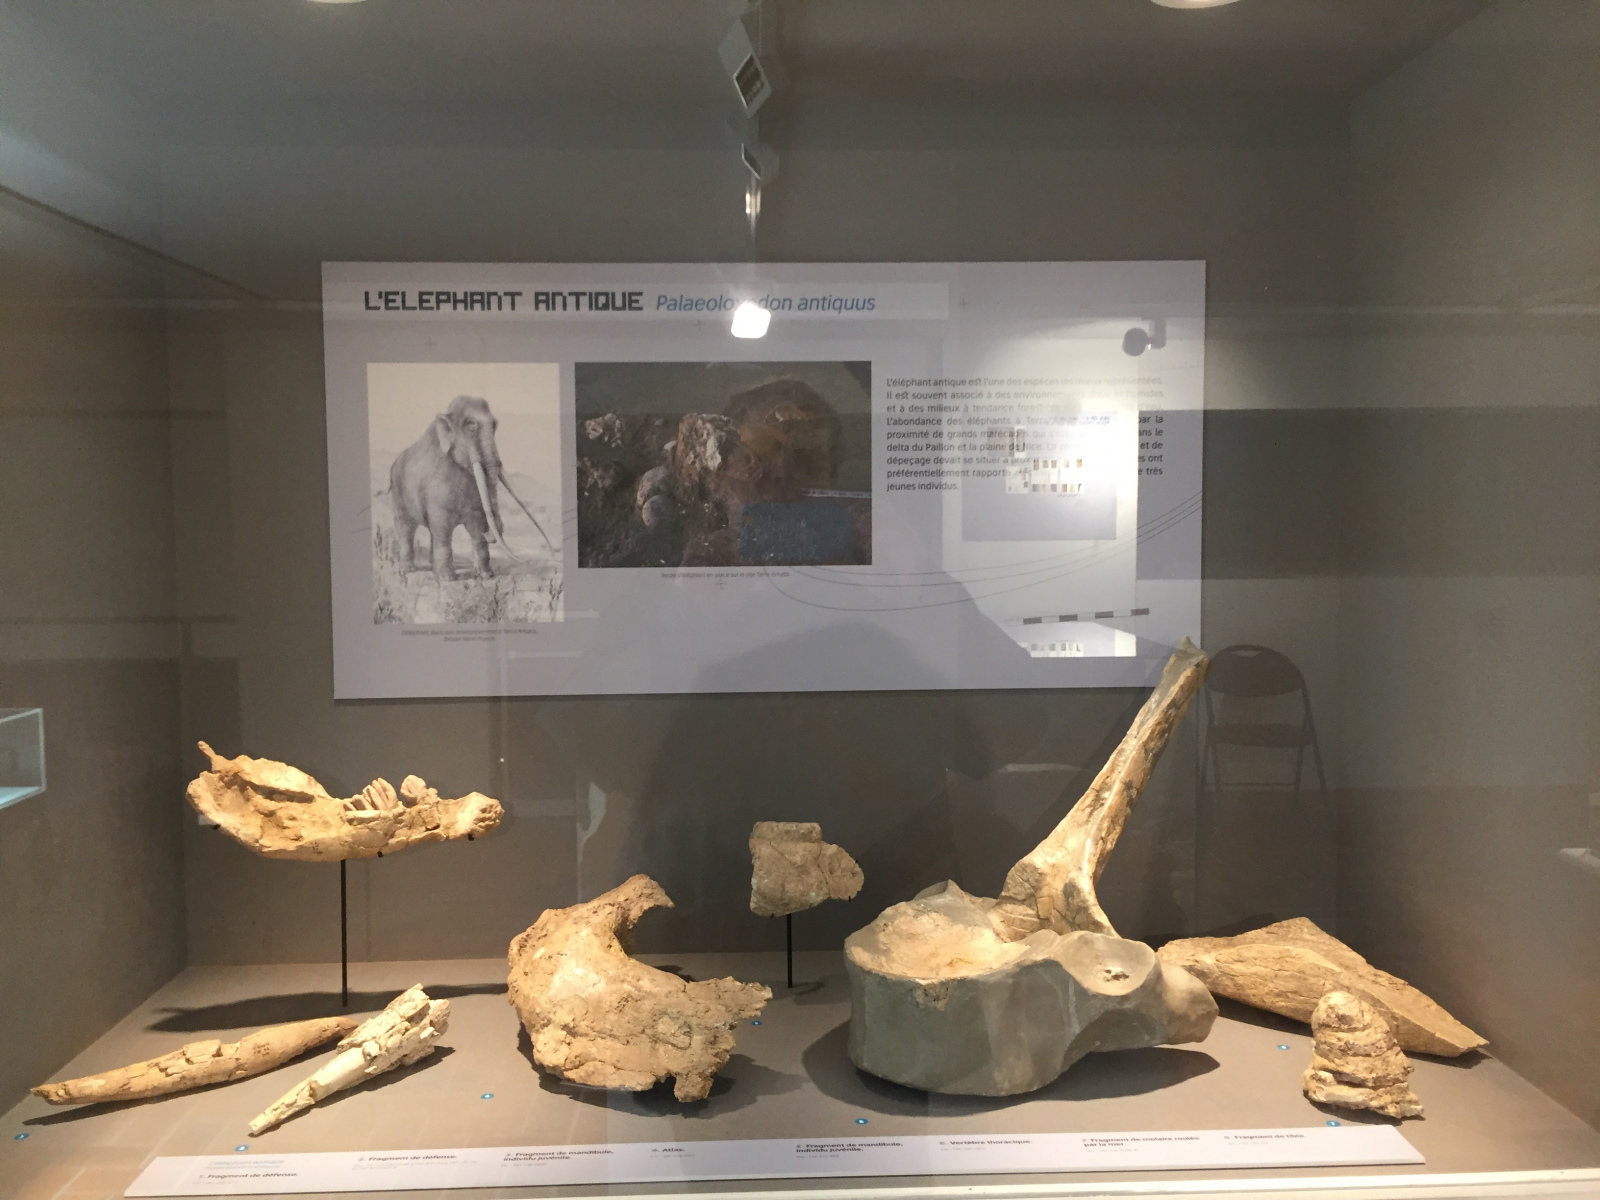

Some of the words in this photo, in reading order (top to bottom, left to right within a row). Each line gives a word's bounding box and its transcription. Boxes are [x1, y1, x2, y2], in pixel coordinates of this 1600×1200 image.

[364, 291, 524, 311] L'ELEPHANT
[535, 292, 643, 311] ANTIQUE
[656, 293, 792, 312] Palaeolodon
[798, 294, 876, 314] antiquus
[887, 378, 931, 387] L'éléphant
[933, 379, 966, 387] antique
[969, 378, 981, 386] est
[984, 378, 1004, 386] l'une
[1007, 378, 1021, 386] des
[900, 404, 905, 412] à
[908, 404, 924, 412] des
[928, 404, 959, 412] milieux
[963, 404, 968, 412] à
[973, 404, 1013, 412] tendance
[887, 418, 942, 426] L'abondance
[967, 417, 1010, 426] éléphants
[887, 430, 929, 440] proximité
[932, 430, 943, 438] de
[947, 430, 977, 440] grands
[887, 443, 909, 451] delta
[912, 443, 923, 451] du
[926, 443, 954, 451] Paillon
[980, 442, 1006, 452] plaine
[887, 456, 930, 466] dépeçage
[934, 456, 961, 464] devait
[887, 469, 969, 478] préférentiellement
[1146, 467, 1163, 475] très
[886, 483, 916, 491] jeunes
[918, 482, 958, 490] individus.
